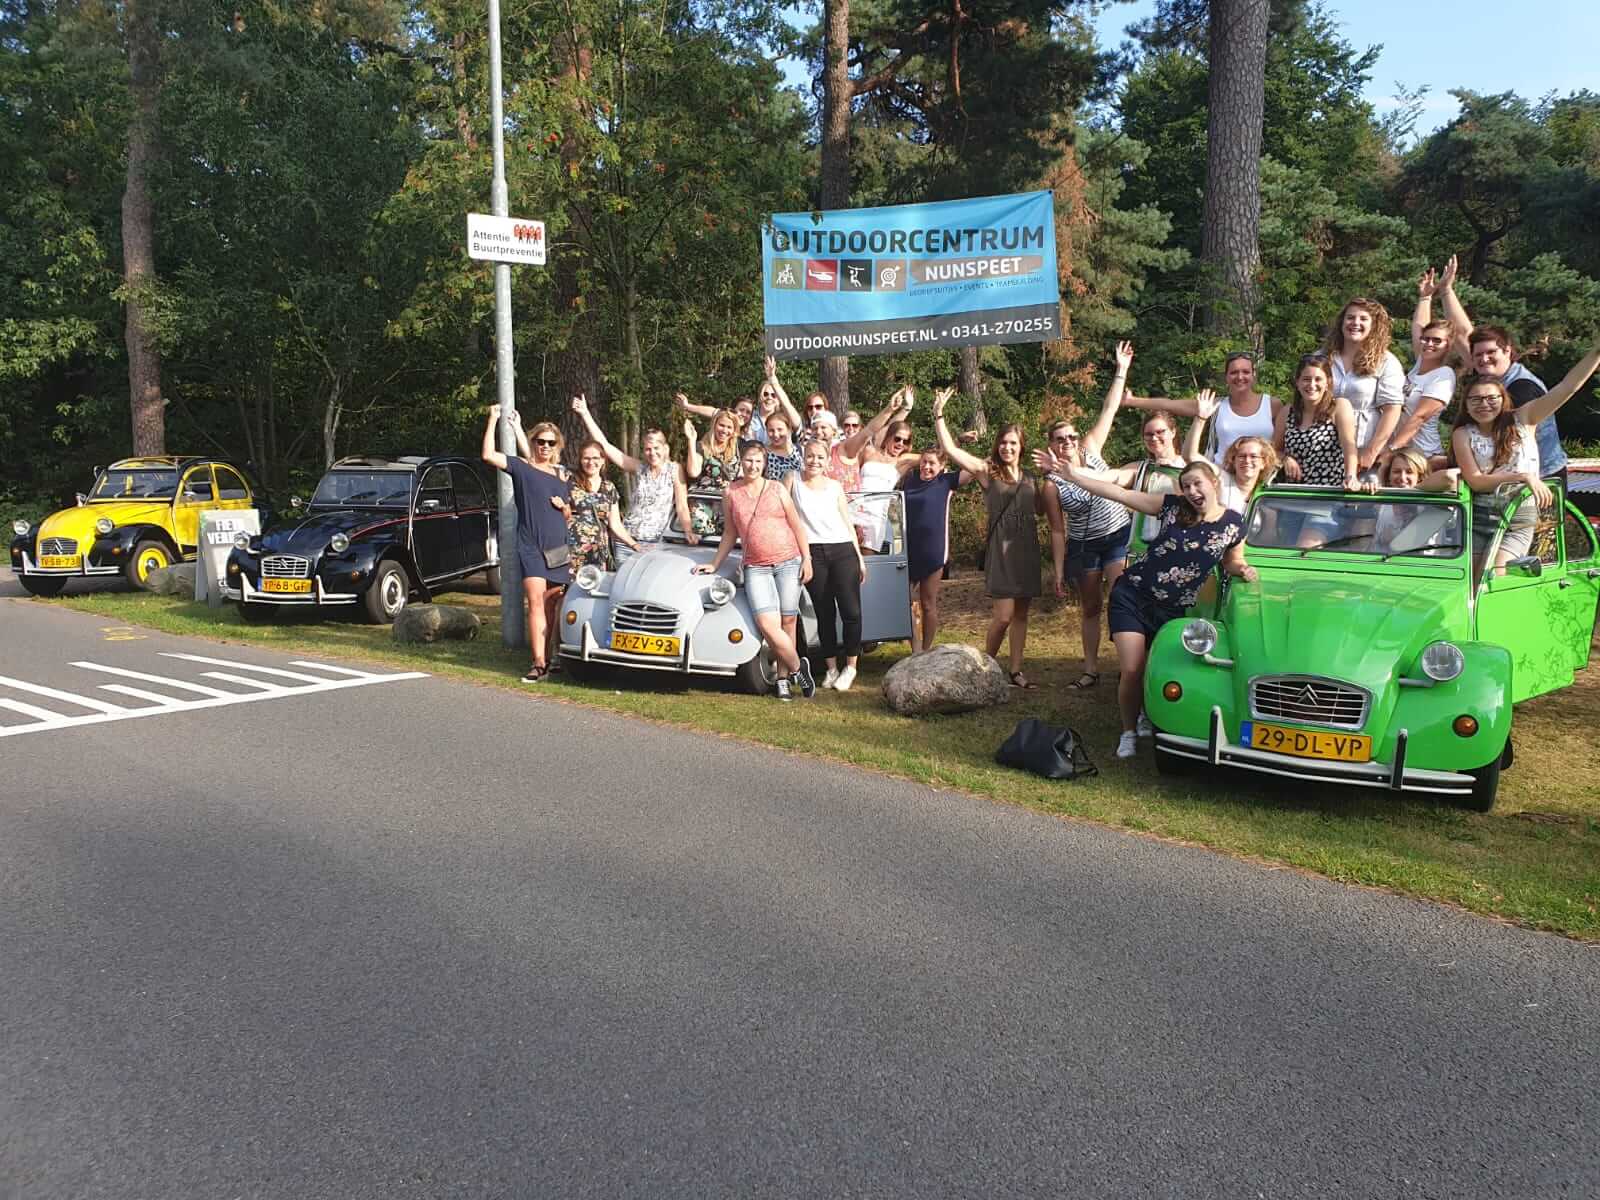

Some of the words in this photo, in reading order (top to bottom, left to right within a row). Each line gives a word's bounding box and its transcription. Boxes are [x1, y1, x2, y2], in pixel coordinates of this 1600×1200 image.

[473, 230, 510, 242] Attentie
[771, 225, 1044, 254] OUTDOORCENTRUM
[473, 243, 543, 258] Buurtpreventie
[925, 256, 1023, 281] NUNSPEET
[774, 328, 939, 351] OUTDOORNUNSPEET.NL
[951, 317, 1053, 339] 0341-270255
[615, 634, 673, 653] FX-ZV-93
[1259, 727, 1363, 757] 29-DL-VP
